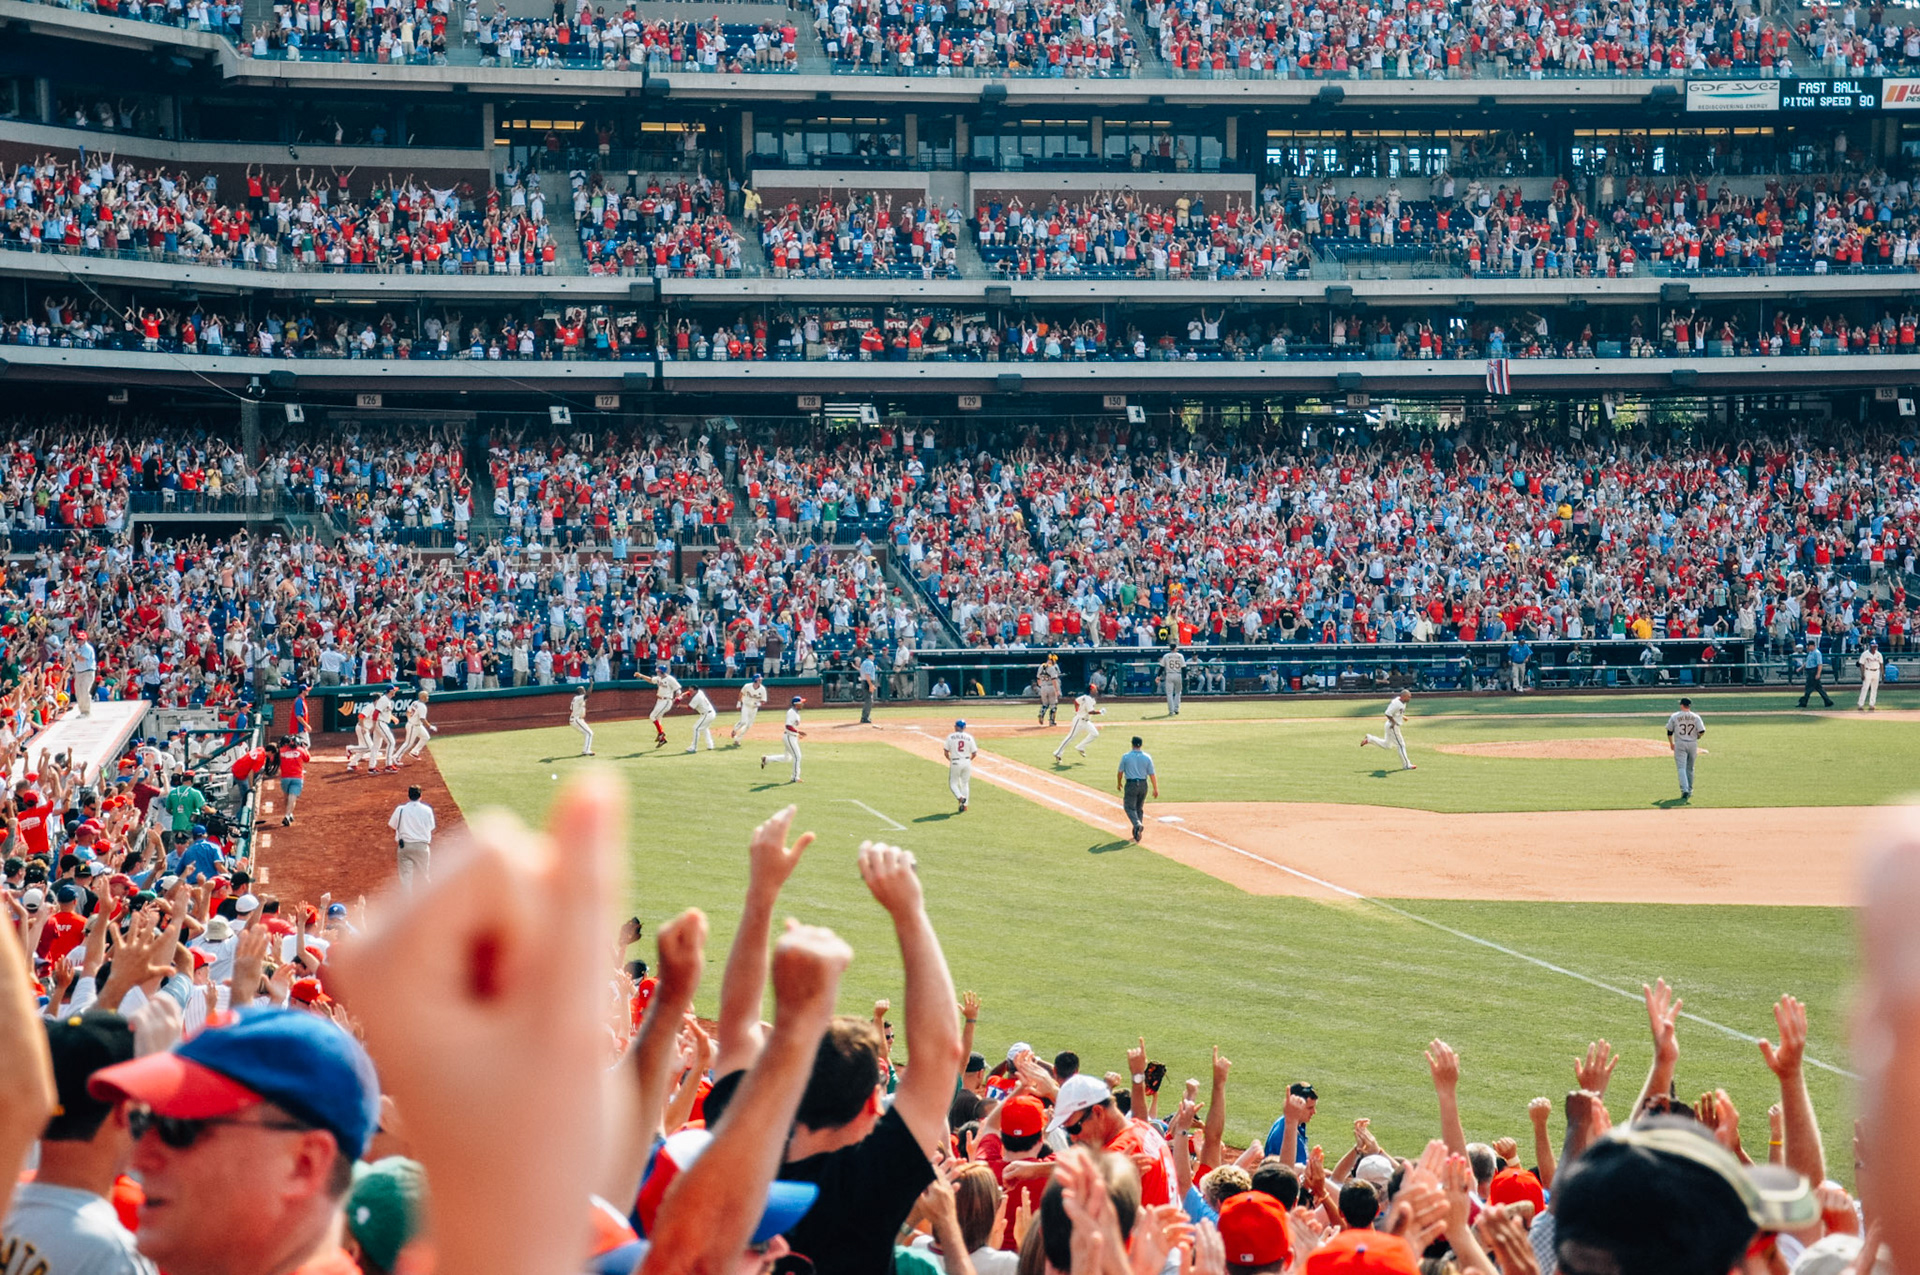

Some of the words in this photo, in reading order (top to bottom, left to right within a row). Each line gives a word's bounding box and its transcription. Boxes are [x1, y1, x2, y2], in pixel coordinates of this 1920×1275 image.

[1688, 83, 1728, 92] GDF
[1798, 81, 1827, 94] FAST
[1833, 81, 1863, 94] BALL
[1783, 96, 1815, 107] PITCH
[1820, 96, 1852, 107] SPEED
[1859, 94, 1875, 107] 90
[362, 395, 376, 405] 126
[600, 396, 614, 406] 127
[803, 396, 816, 406] 128
[963, 396, 977, 406] 129
[1108, 396, 1122, 406] 130
[1168, 659, 1181, 669] 65
[1679, 723, 1696, 736] 37
[957, 740, 965, 752] 2
